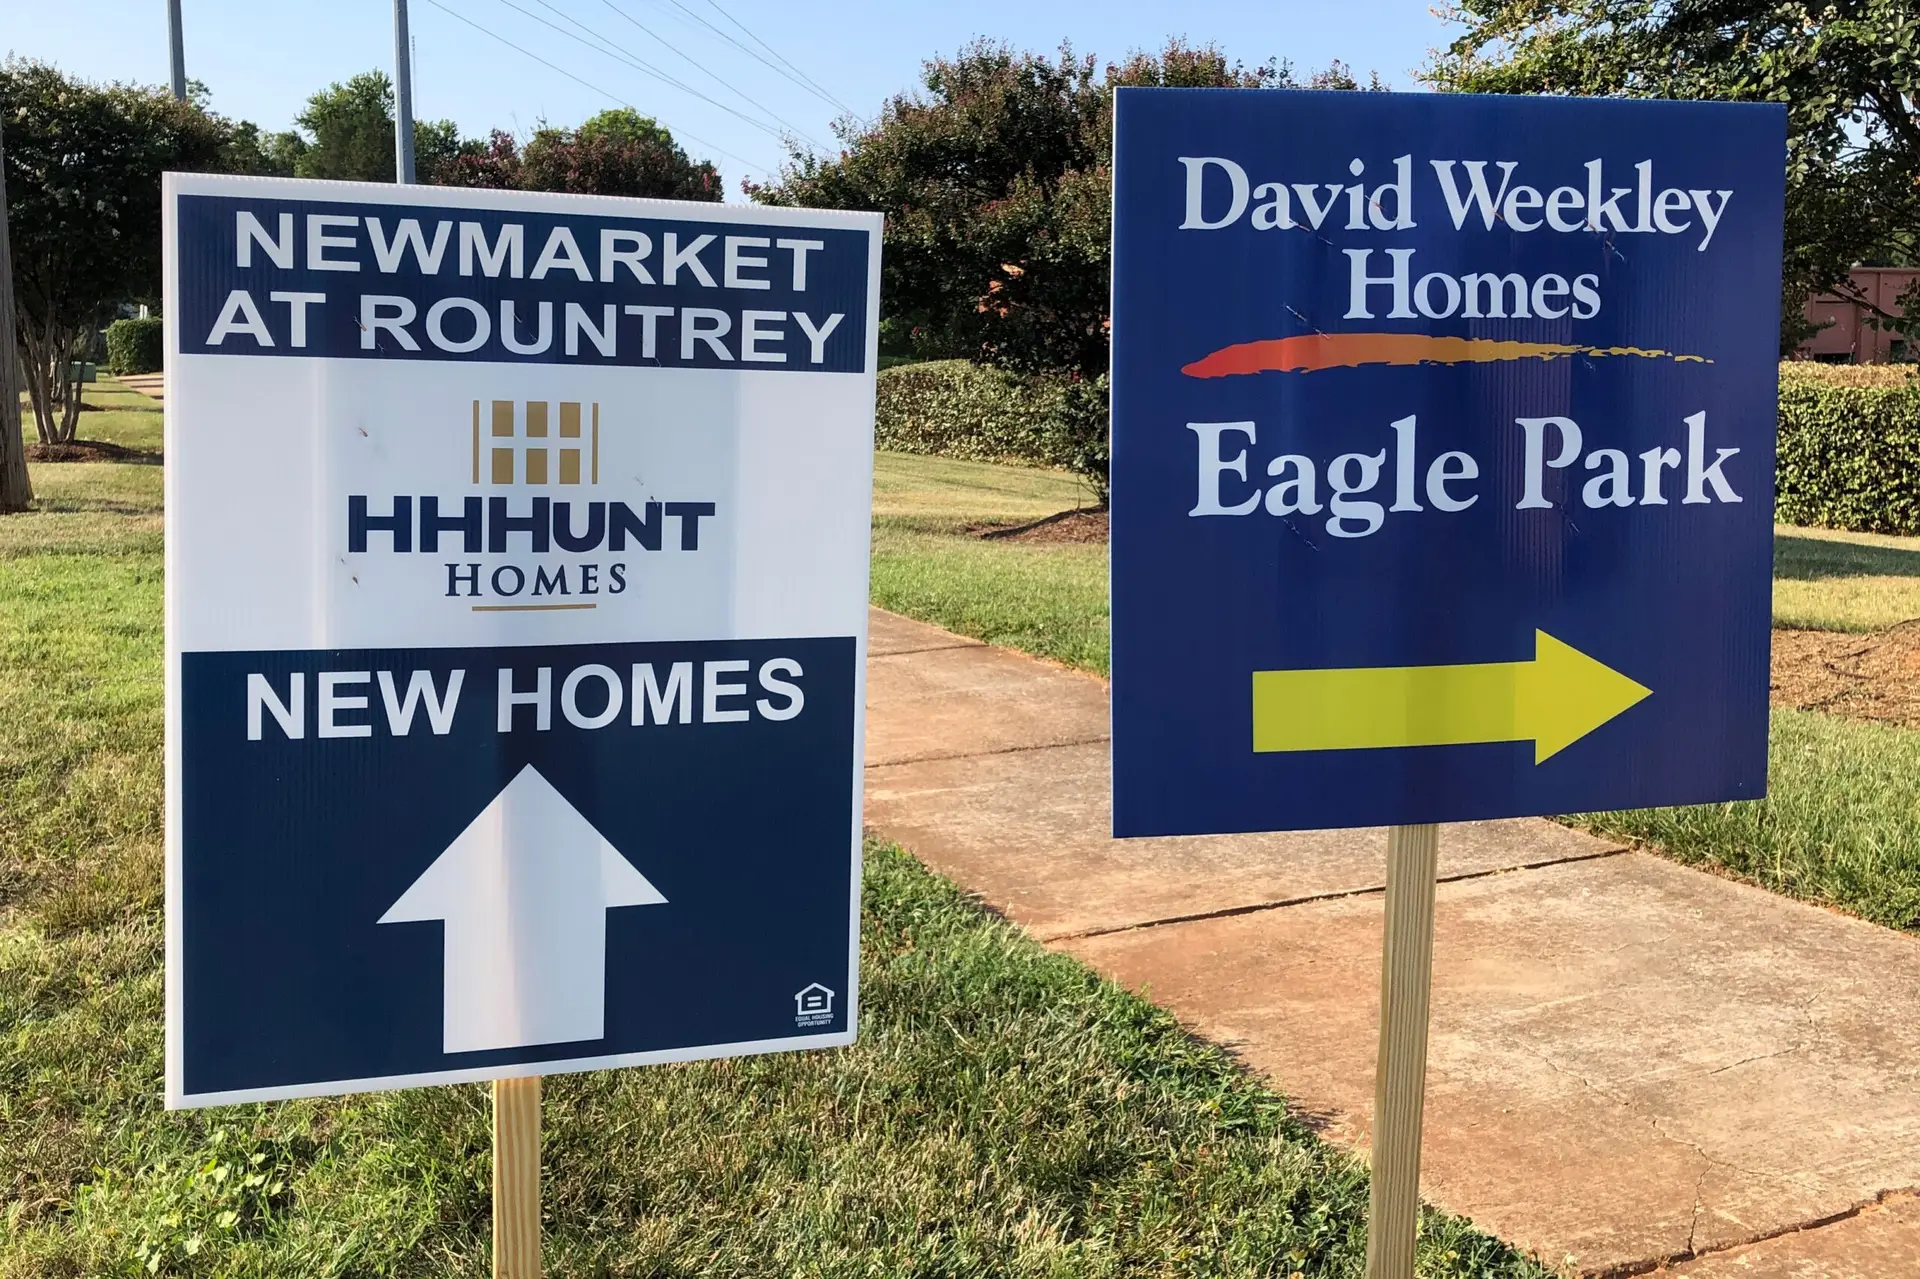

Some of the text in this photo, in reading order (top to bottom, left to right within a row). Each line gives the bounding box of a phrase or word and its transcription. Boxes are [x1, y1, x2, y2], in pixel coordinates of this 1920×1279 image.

[1177, 154, 1733, 251] David Weekley
[236, 211, 823, 291] NEWMARKET
[1342, 248, 1601, 320] Homes
[205, 290, 845, 364] AT ROUNTREY
[1186, 409, 1743, 538] Eagle Park
[349, 495, 715, 552] HHHUNT
[445, 562, 627, 597] HOMES
[247, 658, 805, 741] NEW HOMES
[797, 1019, 831, 1027] OPPORTUNITY
